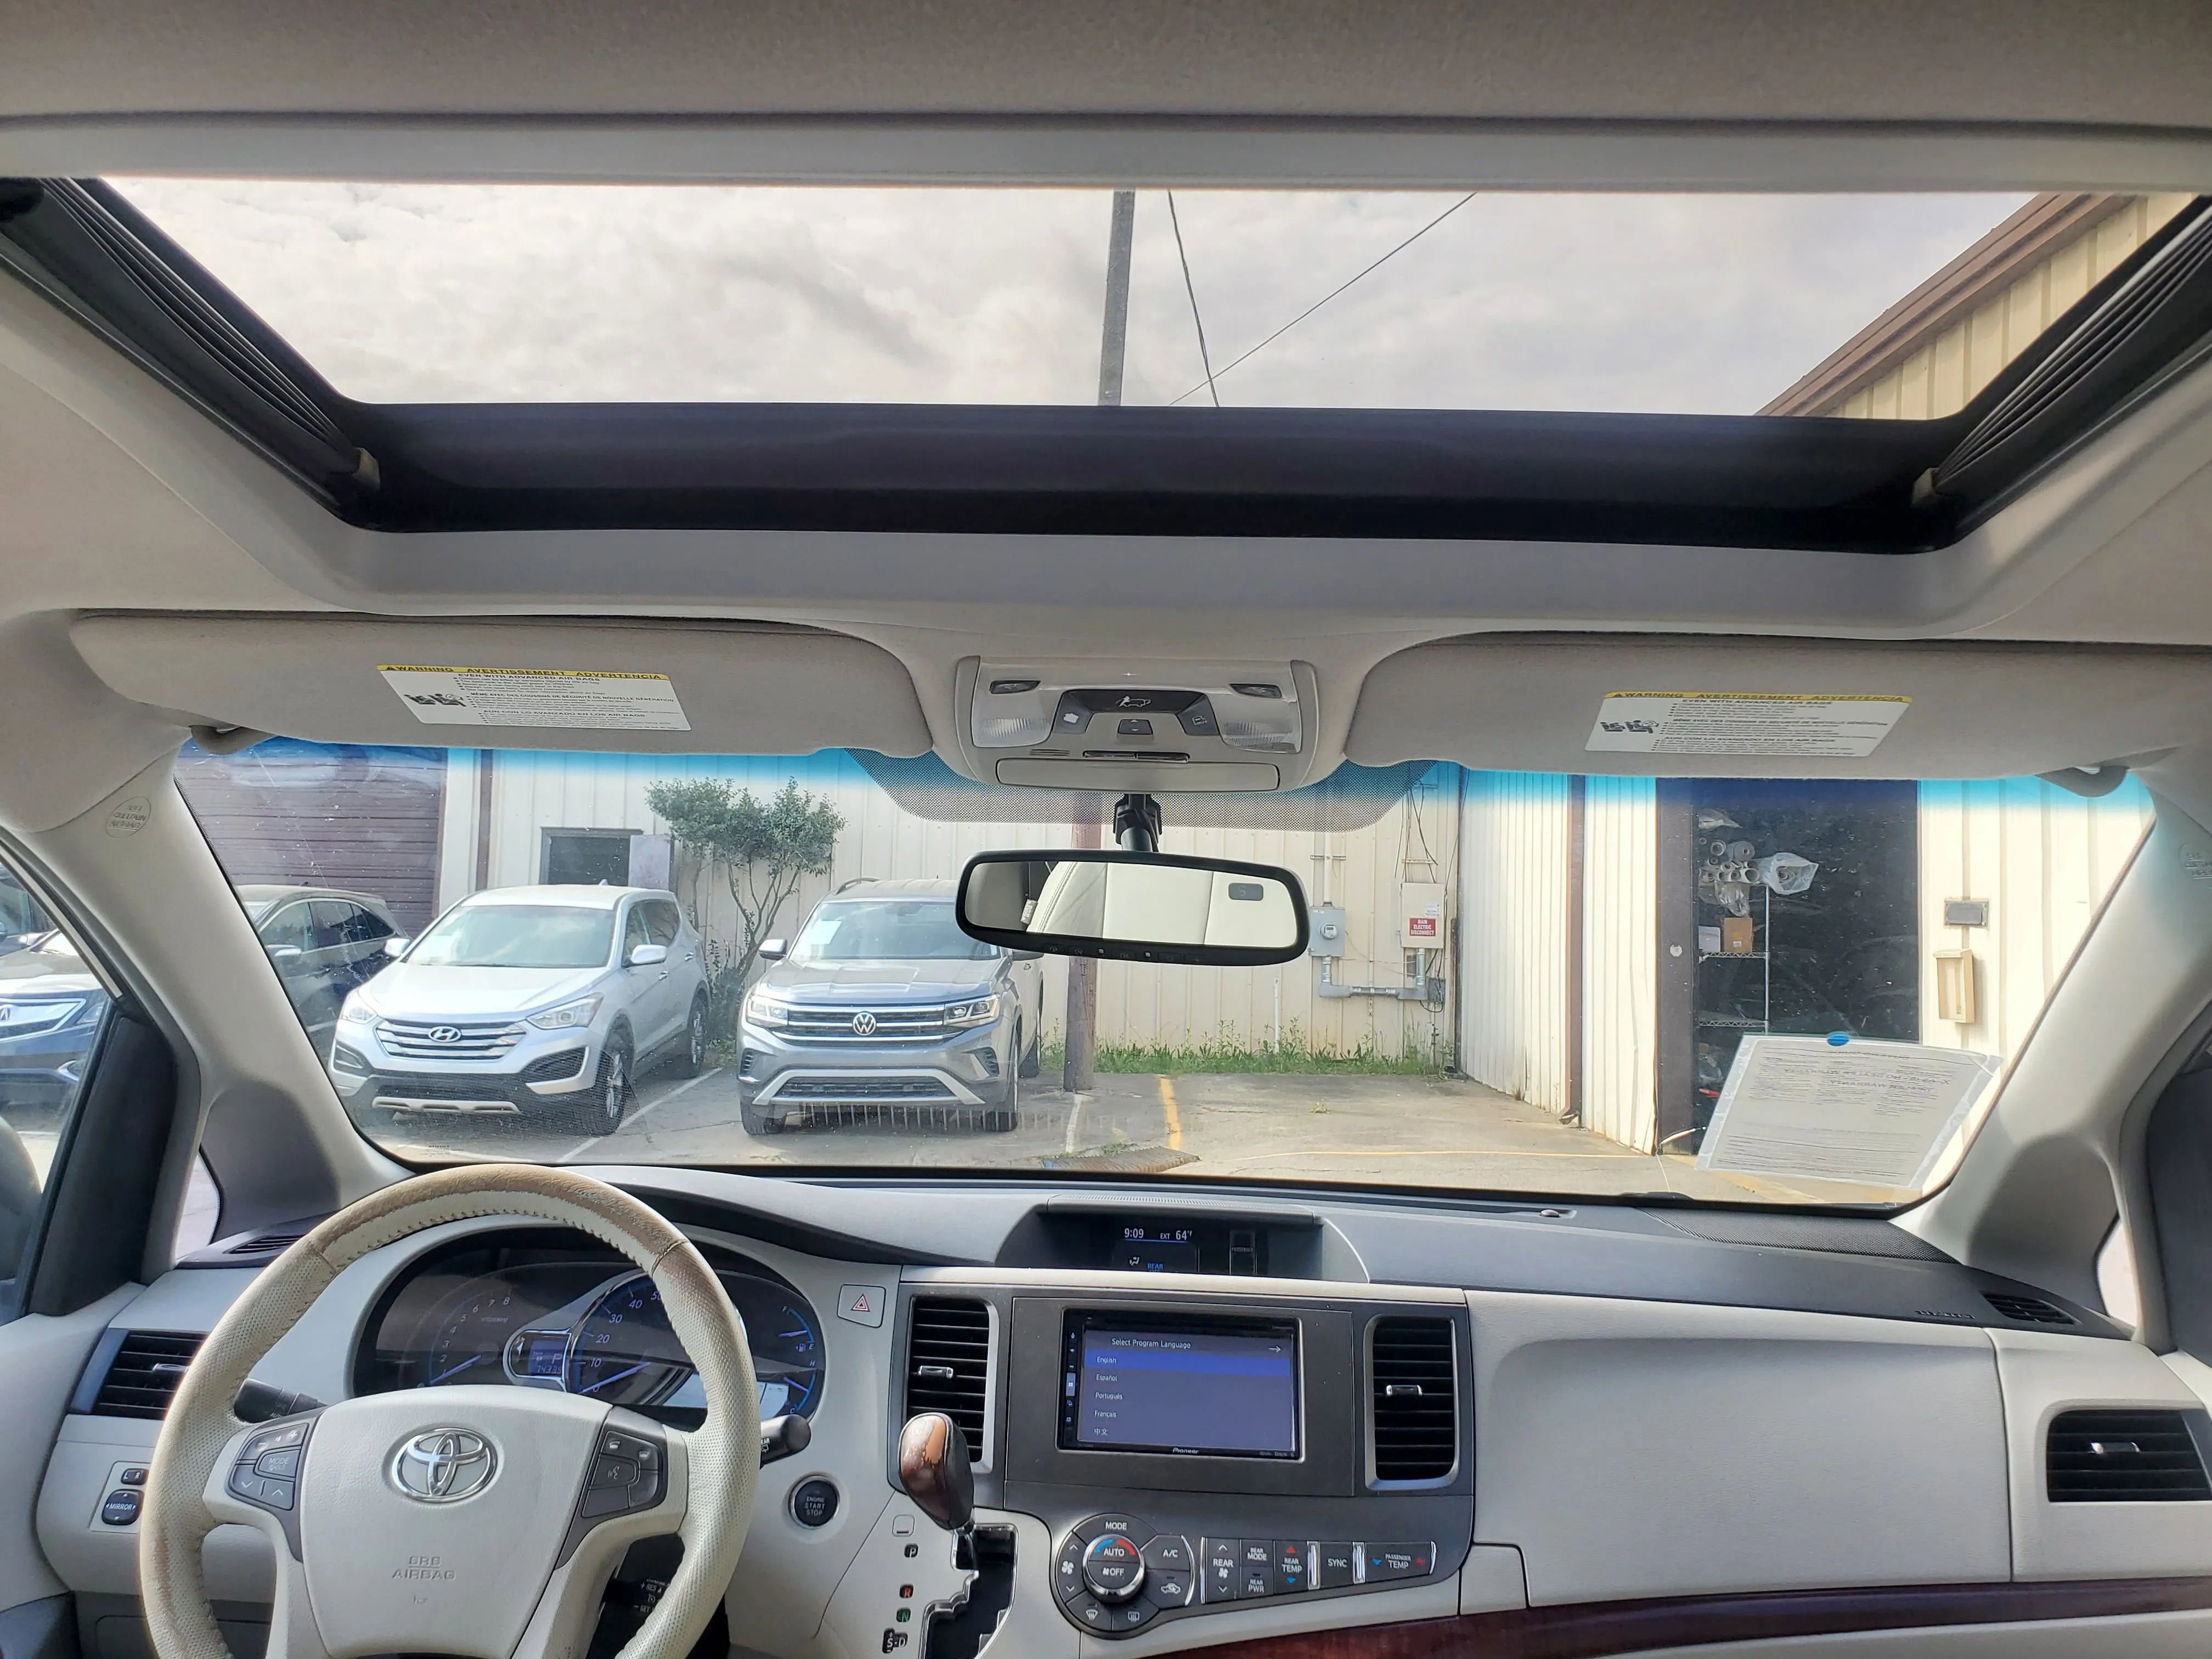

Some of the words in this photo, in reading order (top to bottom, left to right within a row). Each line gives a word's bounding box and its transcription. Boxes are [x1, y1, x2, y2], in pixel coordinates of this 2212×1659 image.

[1124, 1228, 1144, 1239] 9:09
[629, 1299, 642, 1309] 40
[609, 1314, 623, 1323] 30
[595, 1334, 610, 1344] 20
[1132, 1339, 1159, 1347] Program
[1161, 1340, 1191, 1349] Language
[590, 1358, 601, 1367] 10
[1097, 1356, 1116, 1364] English
[1096, 1374, 1118, 1383] Español
[1094, 1410, 1116, 1418] Français
[1105, 1521, 1127, 1531] MODE
[910, 1547, 917, 1558] P
[1103, 1548, 1125, 1557] AUTO
[1163, 1549, 1178, 1558] A/C
[1247, 1552, 1267, 1561] MODE
[1385, 1553, 1412, 1561] PASSENGER
[1213, 1558, 1234, 1567] REAR
[1328, 1558, 1347, 1568] SYNC
[1388, 1560, 1409, 1570] TEMP
[1110, 1568, 1125, 1577] OFF
[1282, 1564, 1302, 1573] TEMP
[392, 1568, 456, 1579] AIRBAG
[646, 1583, 657, 1592] RES
[905, 1588, 911, 1598] R
[640, 1605, 651, 1613] SET
[902, 1611, 910, 1622] N
